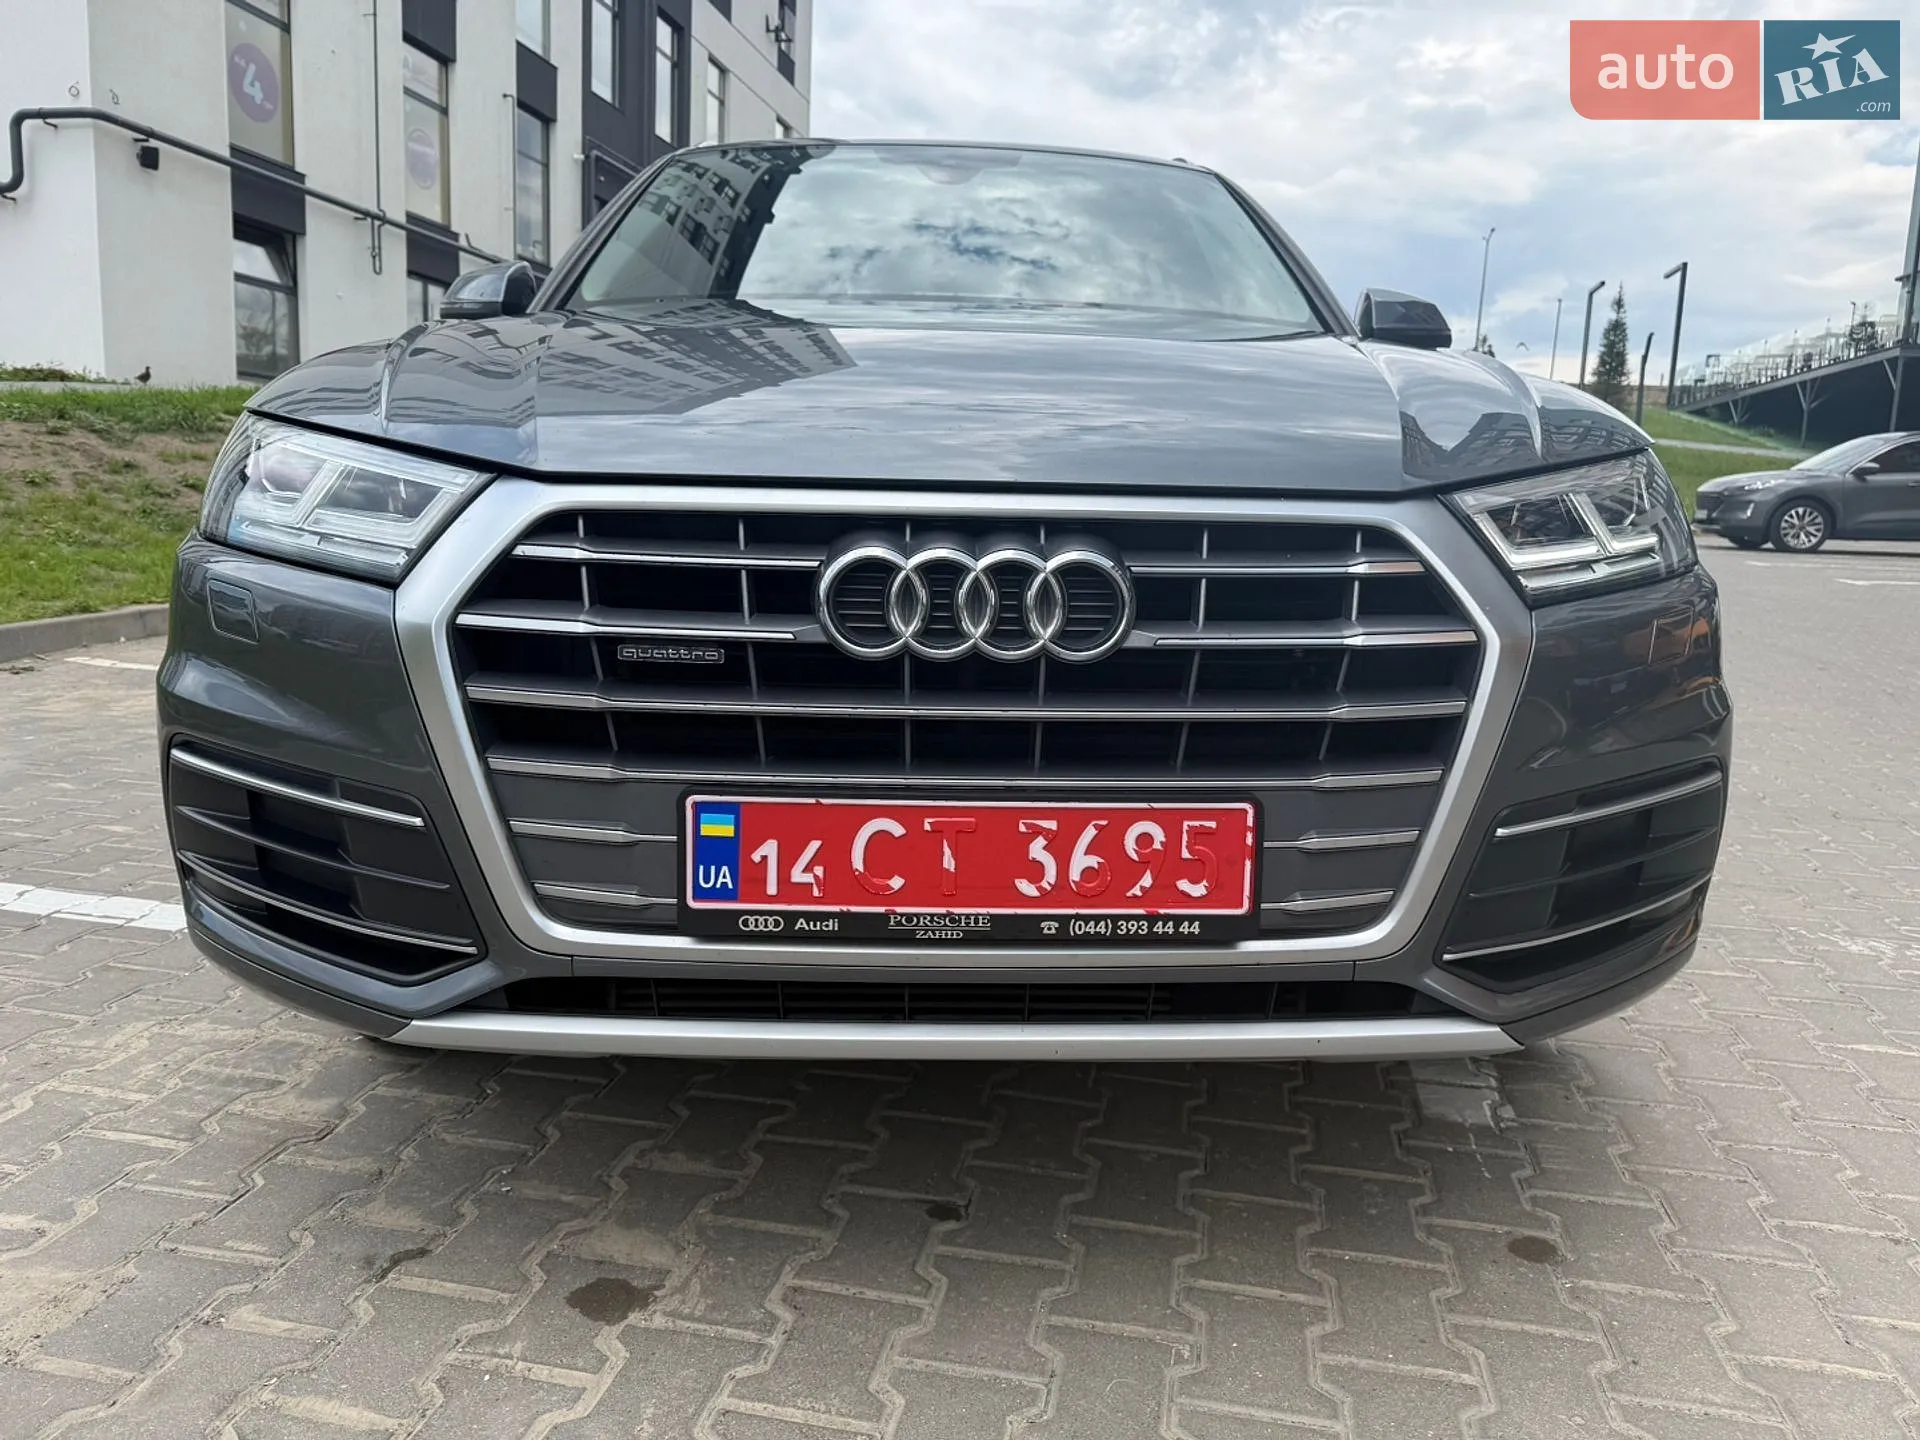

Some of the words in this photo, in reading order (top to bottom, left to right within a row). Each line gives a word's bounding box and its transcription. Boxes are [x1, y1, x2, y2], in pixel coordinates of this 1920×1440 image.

[622, 649, 719, 660] quattro
[750, 838, 825, 898] 14
[851, 817, 976, 896] CT
[1014, 819, 1220, 898] 3695
[698, 865, 734, 889] UA
[794, 917, 840, 932] Audi
[887, 914, 992, 928] PORSCHE
[1069, 918, 1112, 936] (044)
[1116, 920, 1149, 935] 393
[1152, 921, 1175, 935] 44
[1178, 921, 1200, 935] 44
[915, 930, 964, 940] ZAHID
